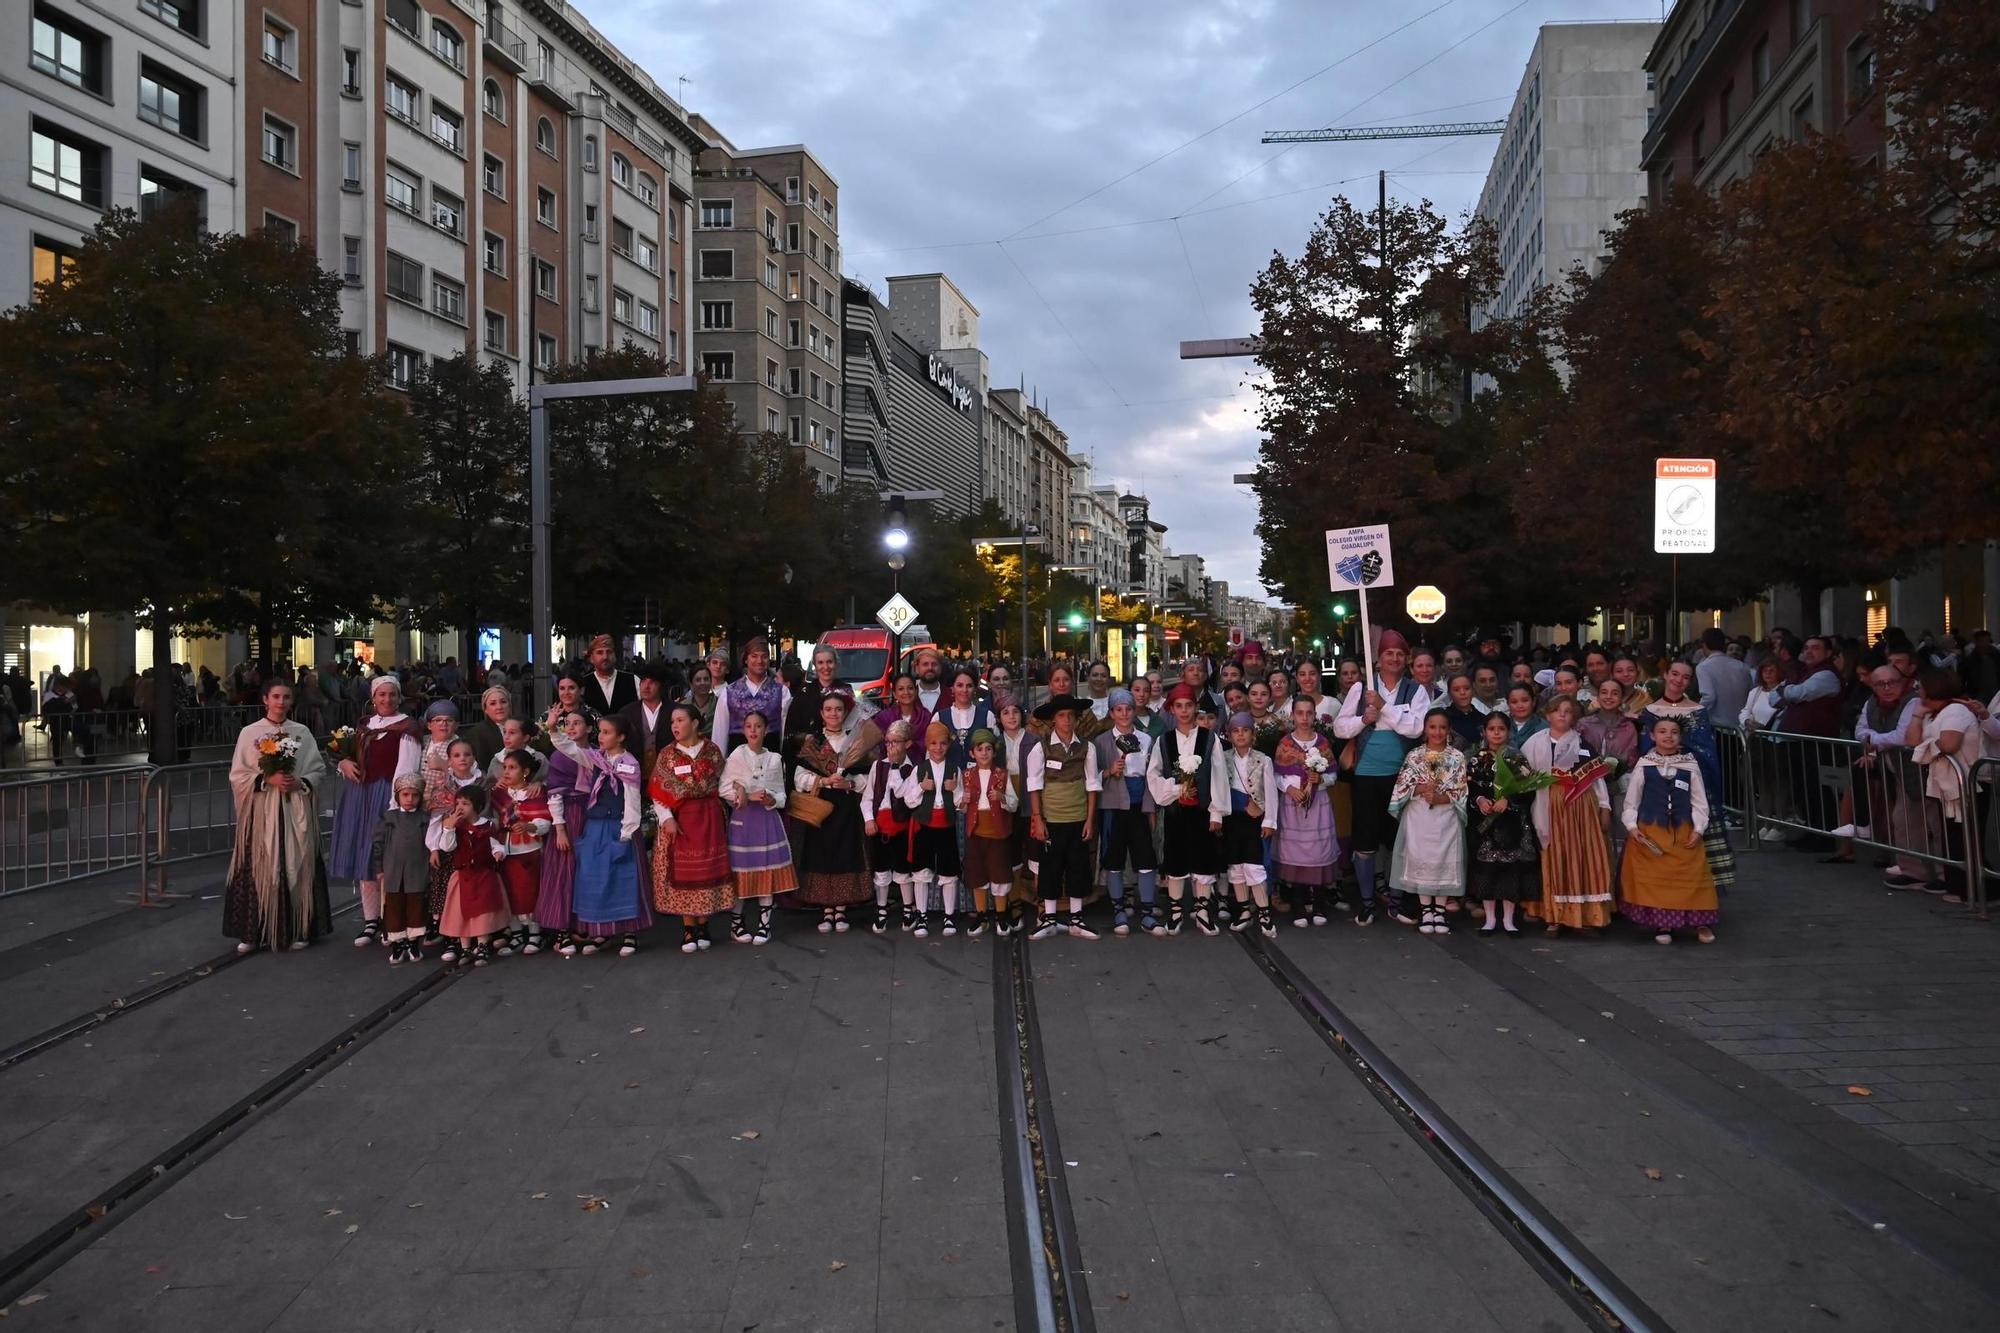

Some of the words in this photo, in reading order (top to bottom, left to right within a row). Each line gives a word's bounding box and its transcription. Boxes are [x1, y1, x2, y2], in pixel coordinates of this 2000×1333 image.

[929, 354, 936, 382] El
[937, 362, 952, 393] Corte
[1663, 464, 1709, 473] ATENCIÓN
[1328, 537, 1353, 545] COLEGIO
[1354, 534, 1375, 542] VIRGEN
[1341, 541, 1375, 550] GUADALUPE
[889, 606, 908, 621] 30
